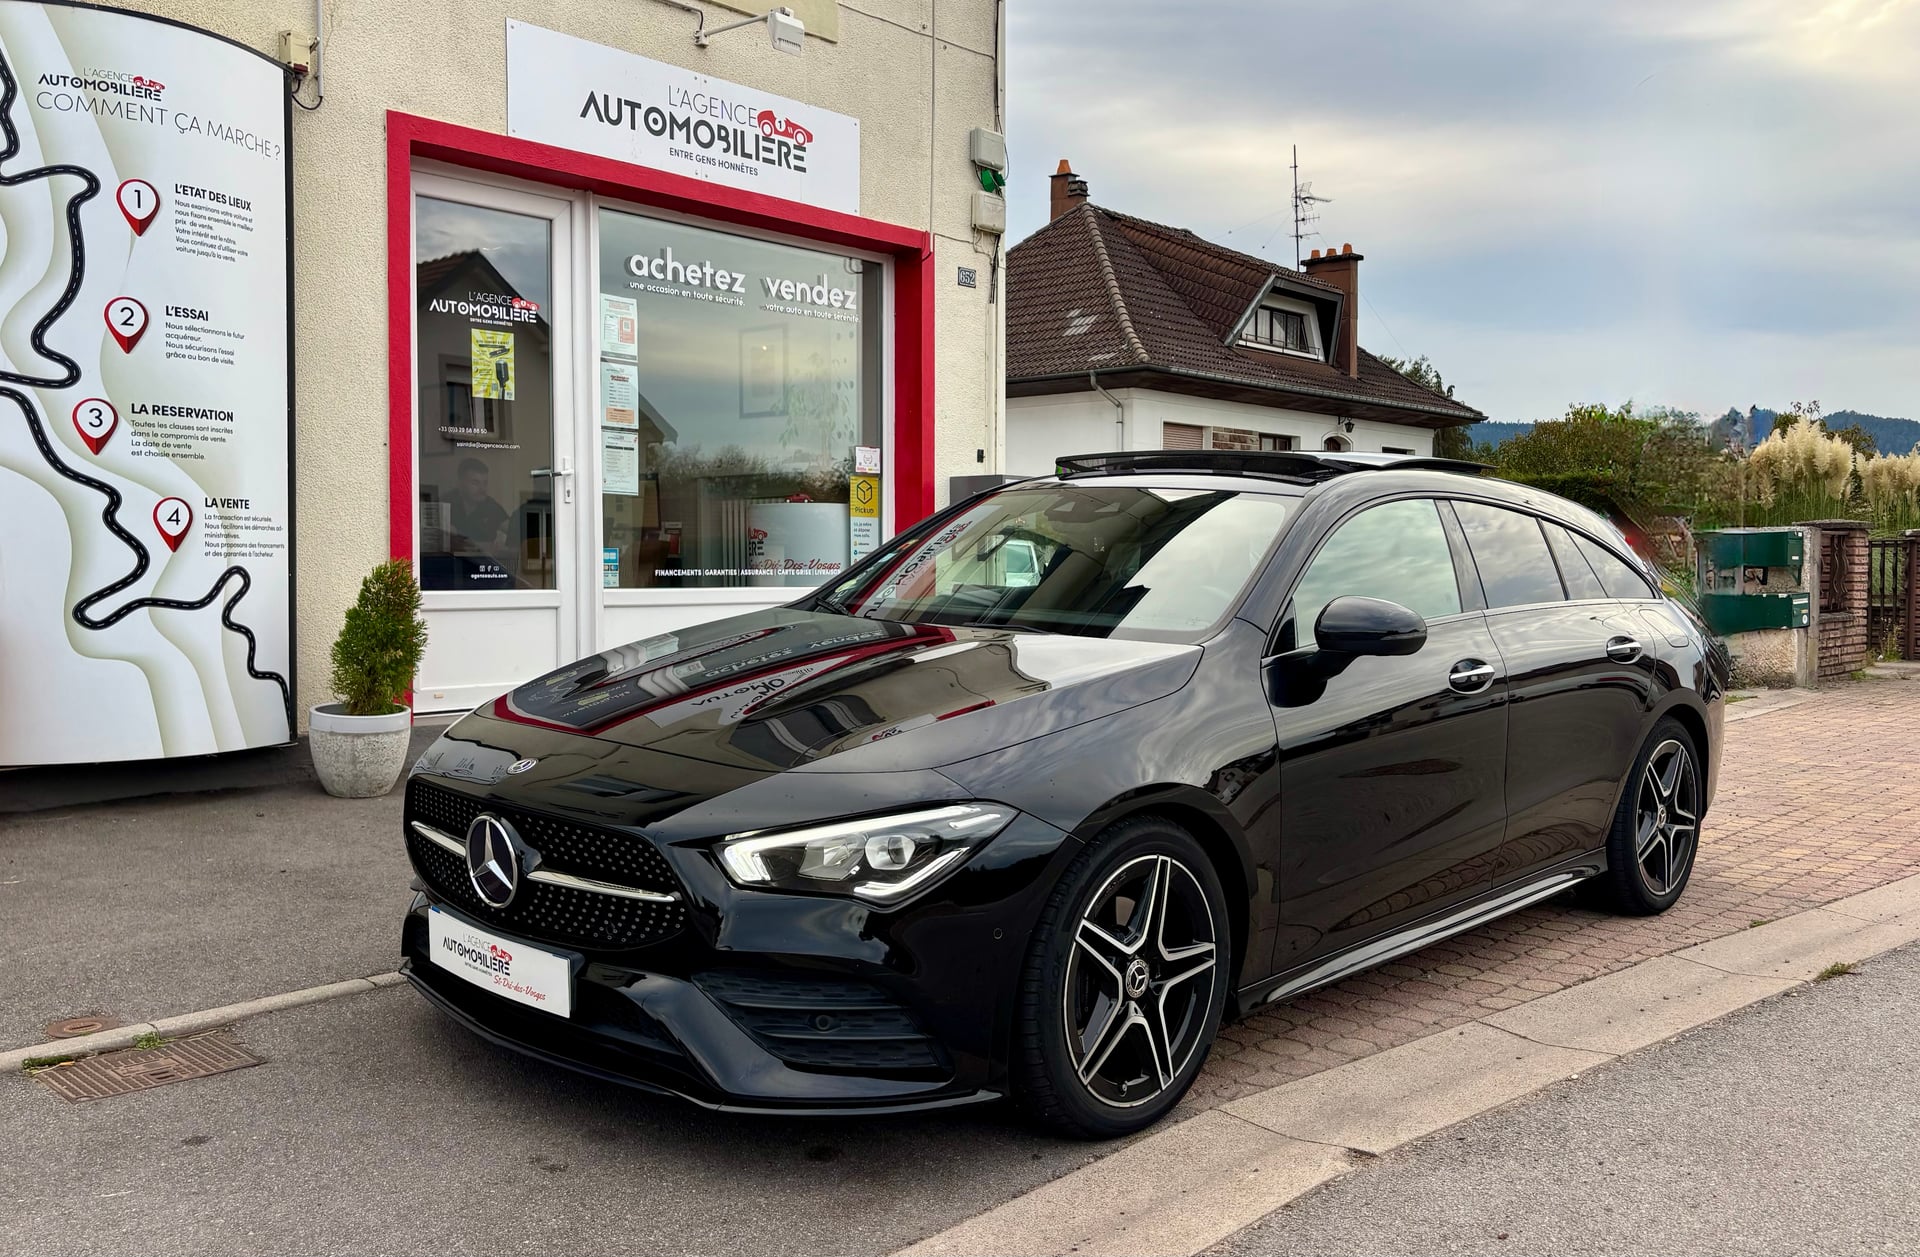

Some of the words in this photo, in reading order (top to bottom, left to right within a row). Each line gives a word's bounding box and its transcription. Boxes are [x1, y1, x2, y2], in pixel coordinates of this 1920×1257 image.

[83, 67, 134, 83] L'AGENCE
[36, 91, 168, 125] COMMENT
[174, 112, 202, 134] ÇA
[668, 84, 758, 128] L'AGENCE
[669, 147, 694, 161] ENTRE
[695, 154, 717, 167] GENS
[718, 160, 759, 176] HONNÊTES
[134, 189, 141, 209] 1
[175, 183, 207, 200] L'ETAT
[209, 190, 227, 204] DES
[228, 196, 252, 212] LIEUX
[191, 203, 220, 214] examinons
[190, 211, 207, 220] fixons
[208, 216, 231, 226] ensemble
[175, 226, 190, 235] Votre
[176, 236, 189, 244] Vous
[191, 239, 216, 249] continuez
[176, 246, 196, 254] voiture
[629, 246, 746, 293] achetez
[468, 291, 512, 306] L'AGENCE
[630, 282, 644, 290] une
[647, 285, 679, 296] occasion
[682, 290, 691, 298] en
[693, 291, 713, 301] toute
[715, 294, 746, 306] sécurité.
[766, 274, 856, 310] vendez
[120, 306, 134, 326] 2
[165, 305, 209, 322] L'ESSAI
[766, 304, 784, 313] votre
[786, 306, 802, 315] auto
[814, 310, 832, 319] toute
[165, 322, 183, 330] Nous
[184, 325, 226, 337] sélectionnons
[227, 330, 232, 338] le
[165, 332, 202, 342] acquéreur.
[165, 341, 183, 349] Nous
[185, 344, 217, 354] sécurisons
[165, 351, 186, 359] grâce
[198, 354, 210, 362] bon
[88, 408, 104, 428] 3
[131, 403, 149, 415] LA
[152, 404, 234, 422] RESERVATION
[131, 420, 156, 428] Toutes
[157, 421, 167, 429] les
[169, 423, 195, 431] clauses
[210, 426, 233, 434] inscrites
[131, 430, 150, 438] dans
[160, 432, 199, 441] compromis
[200, 434, 209, 442] de
[142, 440, 160, 448] date
[172, 442, 192, 450] vente
[144, 450, 170, 458] choisie
[205, 497, 218, 508] LA
[220, 497, 250, 510] VENTE
[855, 506, 874, 514] Pickup
[166, 507, 181, 526] 4
[252, 524, 275, 532] démarches
[221, 542, 248, 550] proposons
